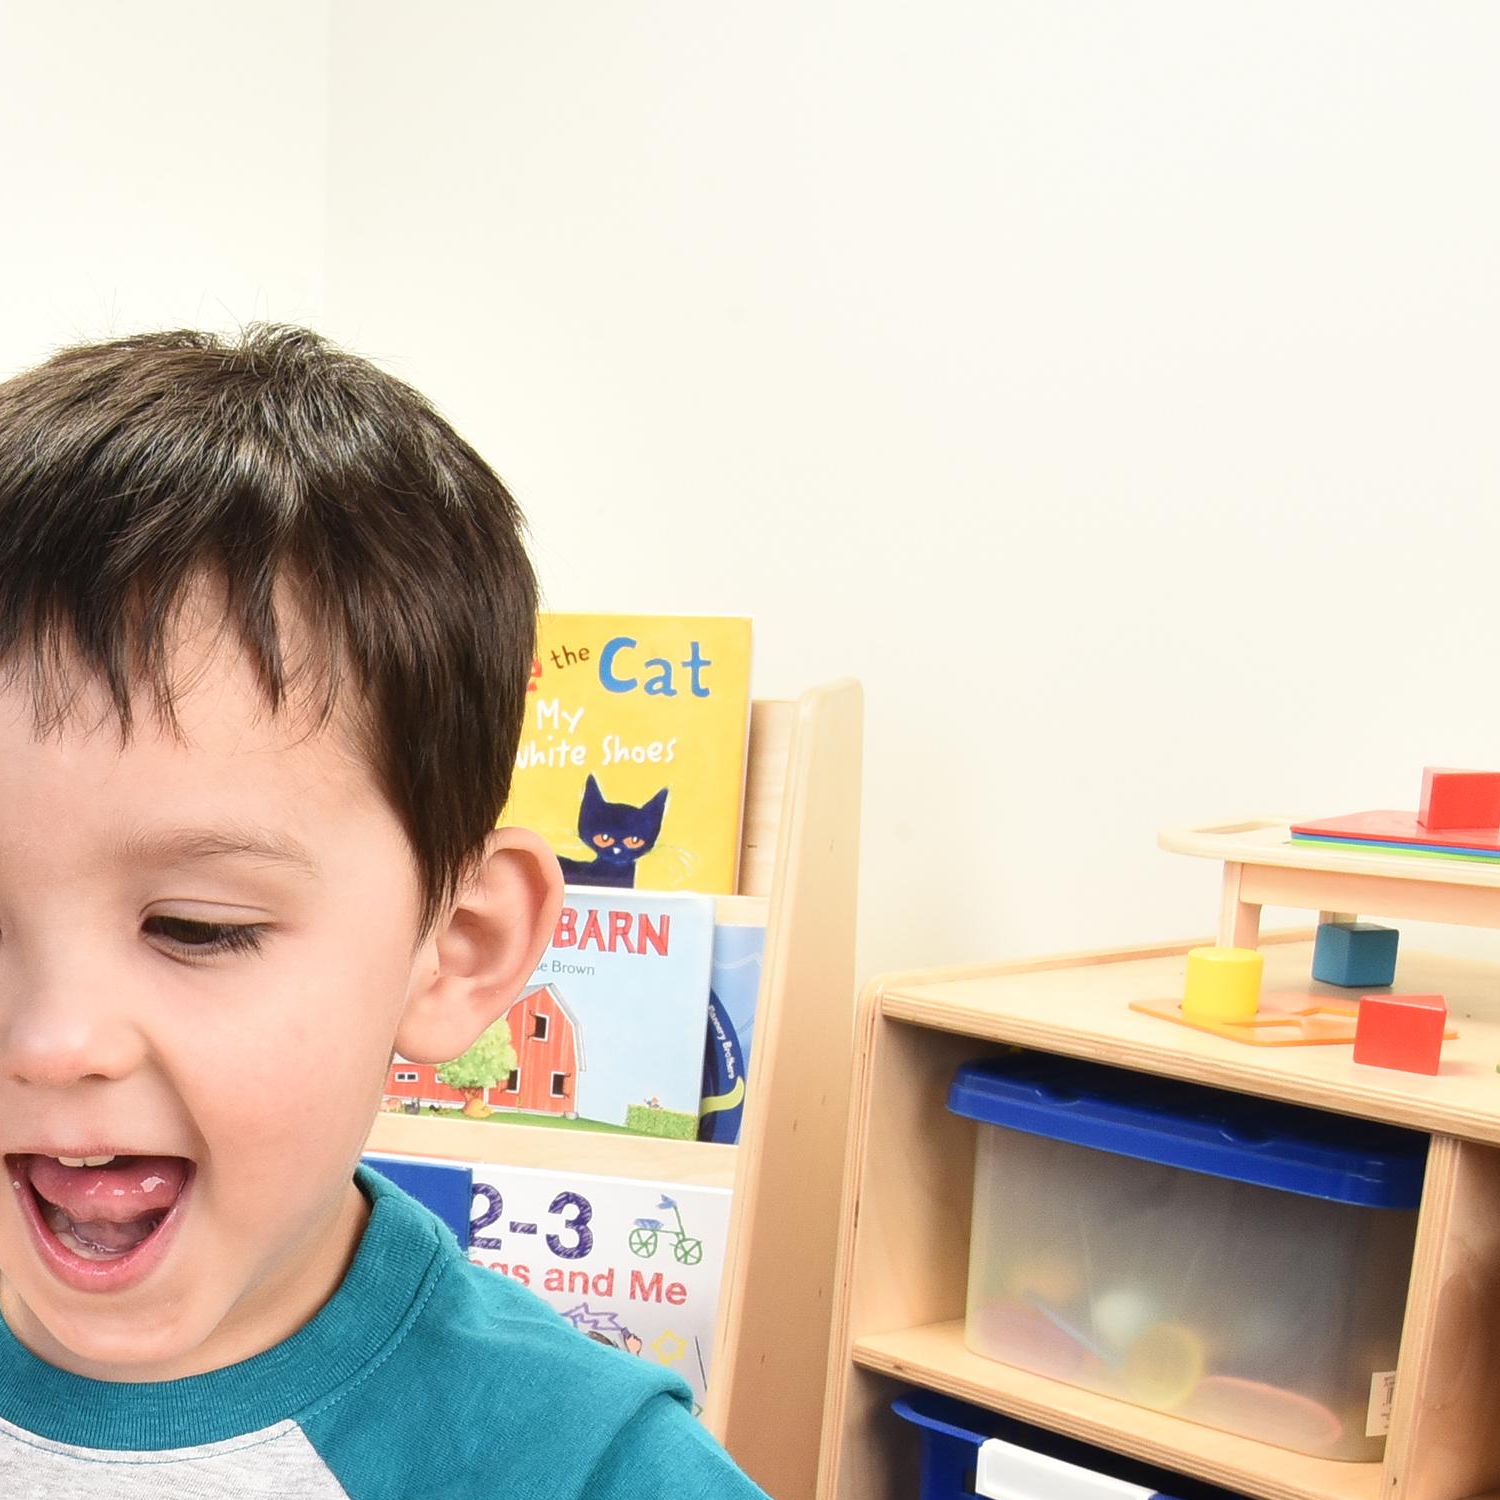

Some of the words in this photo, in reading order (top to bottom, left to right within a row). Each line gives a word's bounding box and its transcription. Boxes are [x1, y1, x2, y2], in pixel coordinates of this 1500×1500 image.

[550, 645, 590, 670] the
[599, 637, 712, 698] Cat
[536, 698, 585, 733] My
[552, 908, 670, 956] BARN
[551, 960, 596, 976] Brown
[543, 1268, 615, 1298] and
[629, 1269, 688, 1306] Me
